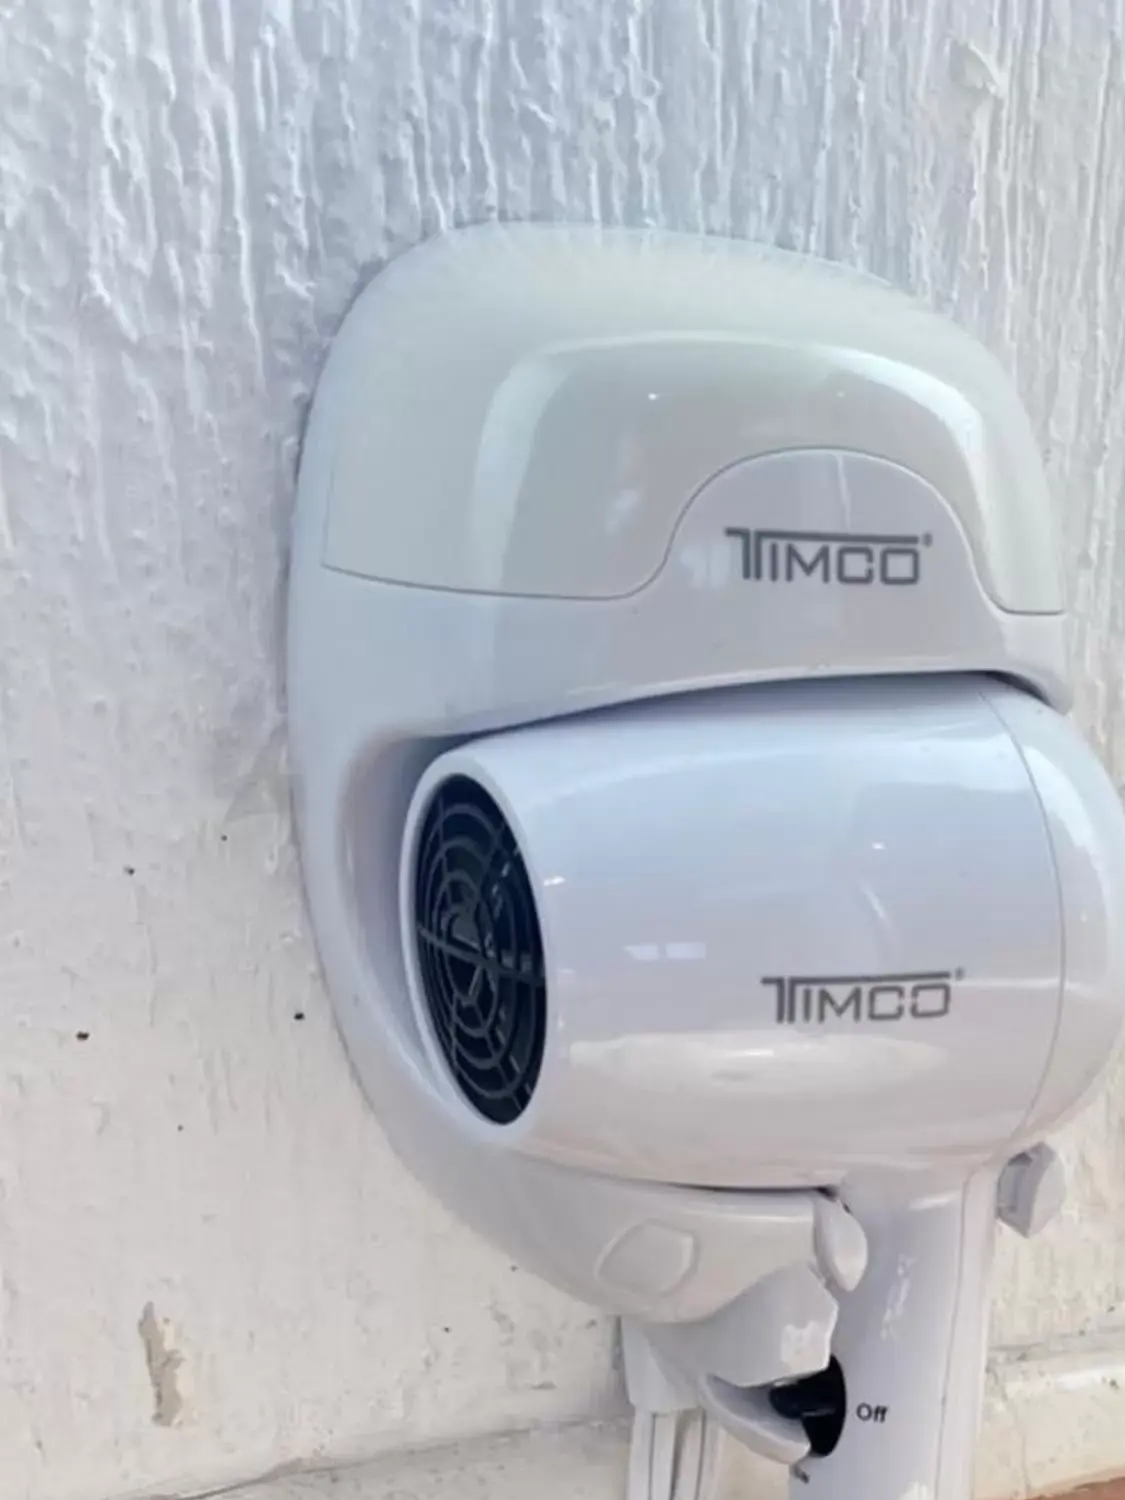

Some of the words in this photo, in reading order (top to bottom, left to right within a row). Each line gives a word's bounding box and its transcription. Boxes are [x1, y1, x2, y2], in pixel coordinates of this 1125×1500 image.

[723, 527, 920, 586] TIMCO
[760, 970, 952, 1024] TIMCO
[856, 1402, 888, 1424] Off
